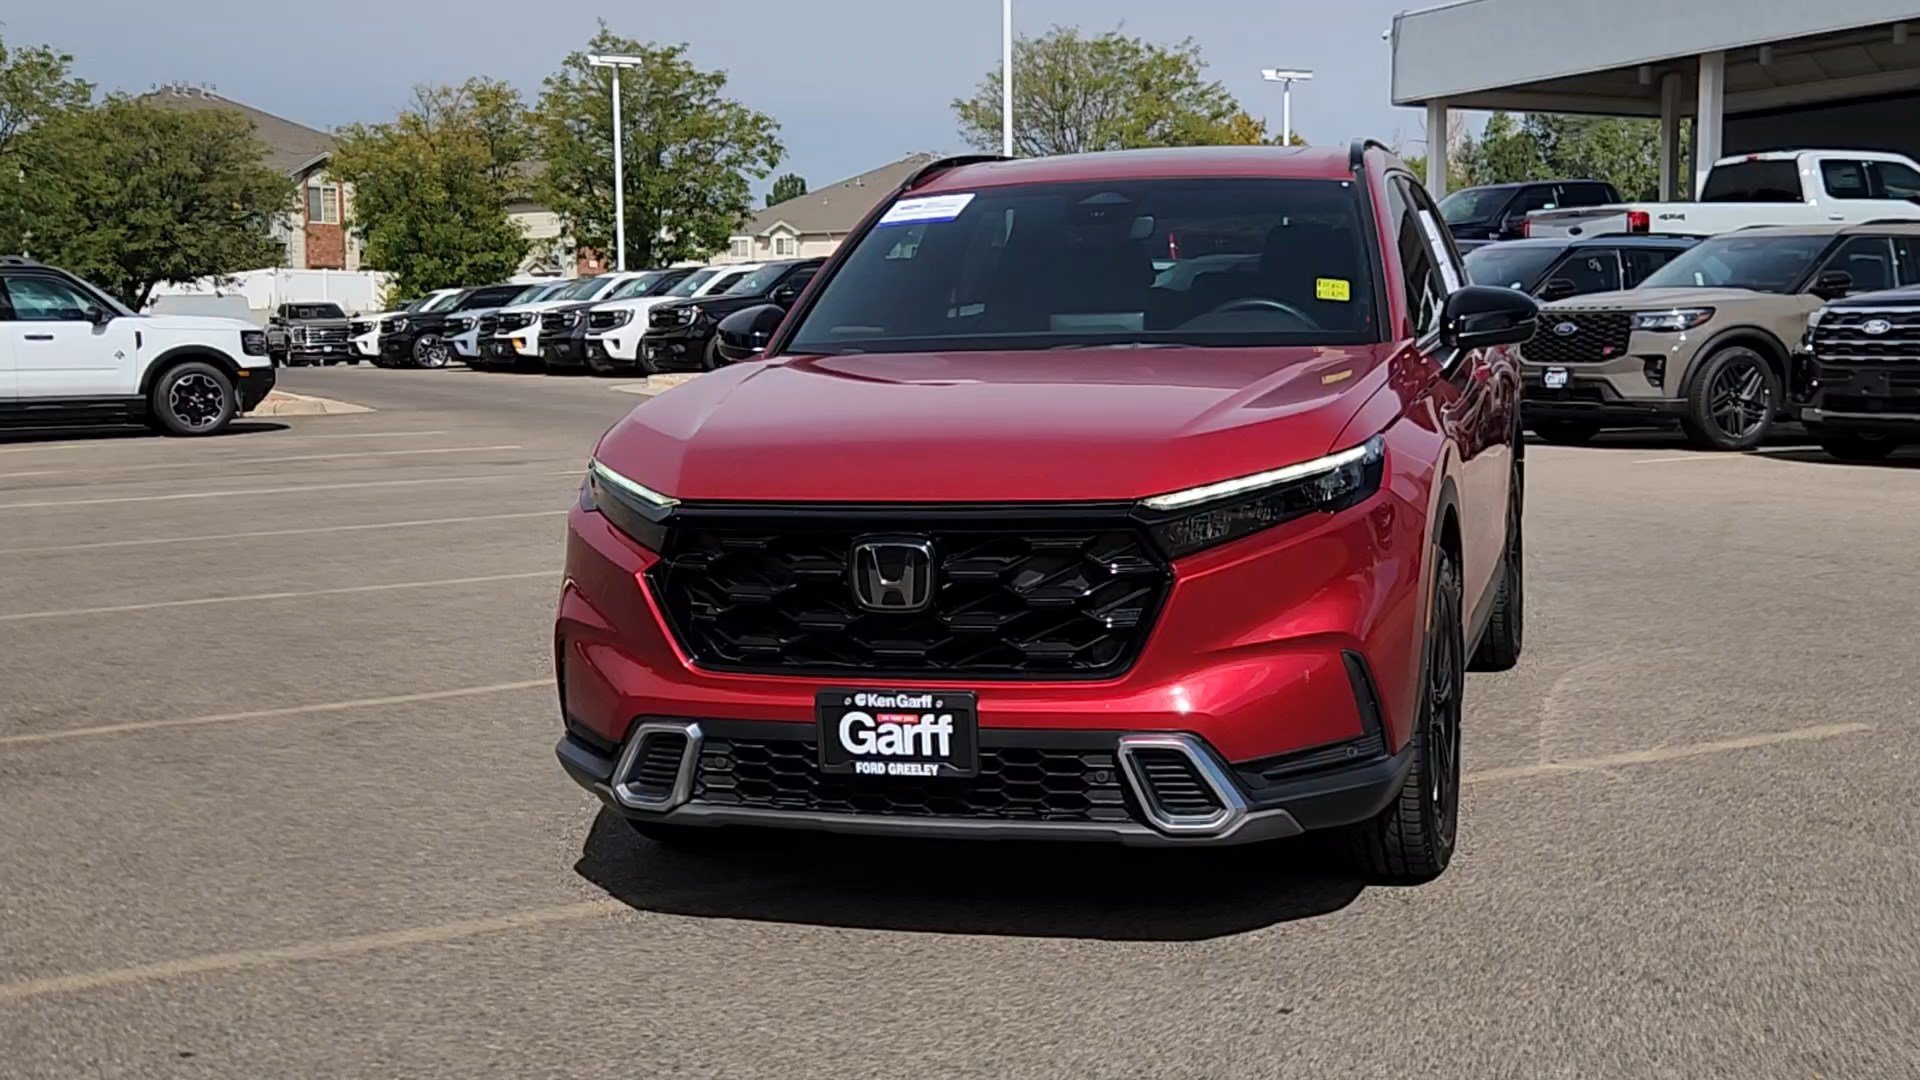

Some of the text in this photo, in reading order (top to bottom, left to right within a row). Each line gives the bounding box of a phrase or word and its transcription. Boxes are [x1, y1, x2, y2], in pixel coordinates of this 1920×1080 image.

[868, 694, 896, 708] Ken
[897, 695, 932, 708] Garff
[839, 711, 953, 756] Garff
[855, 762, 939, 776] FORD GREELEY
